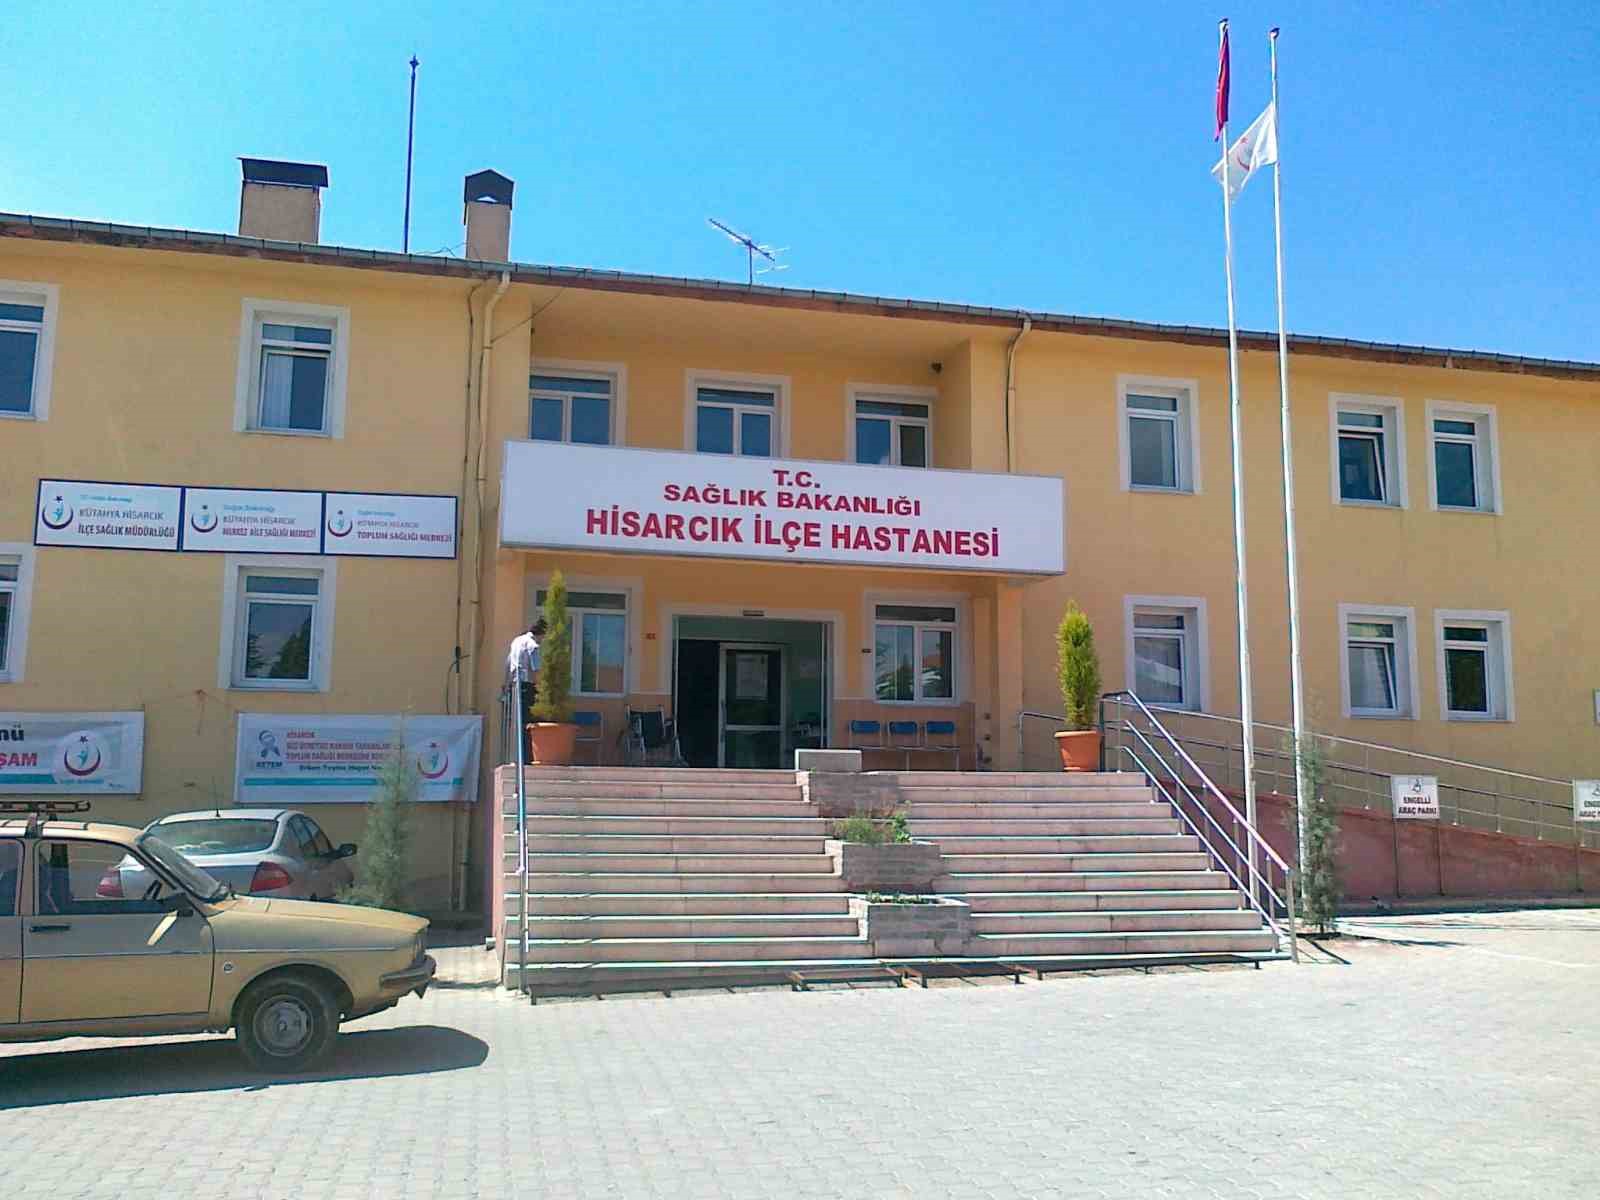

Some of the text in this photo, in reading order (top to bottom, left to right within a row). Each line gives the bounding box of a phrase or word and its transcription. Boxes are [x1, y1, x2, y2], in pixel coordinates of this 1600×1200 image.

[772, 469, 821, 488] T.C.
[664, 483, 921, 516] SAĞLIK BAKANLIĞI
[78, 523, 175, 538] İLÇE SAĞLIK MÜDÜRLÜĞÜ
[586, 505, 1000, 557] HİSARCIK İLÇE HASTANESİ
